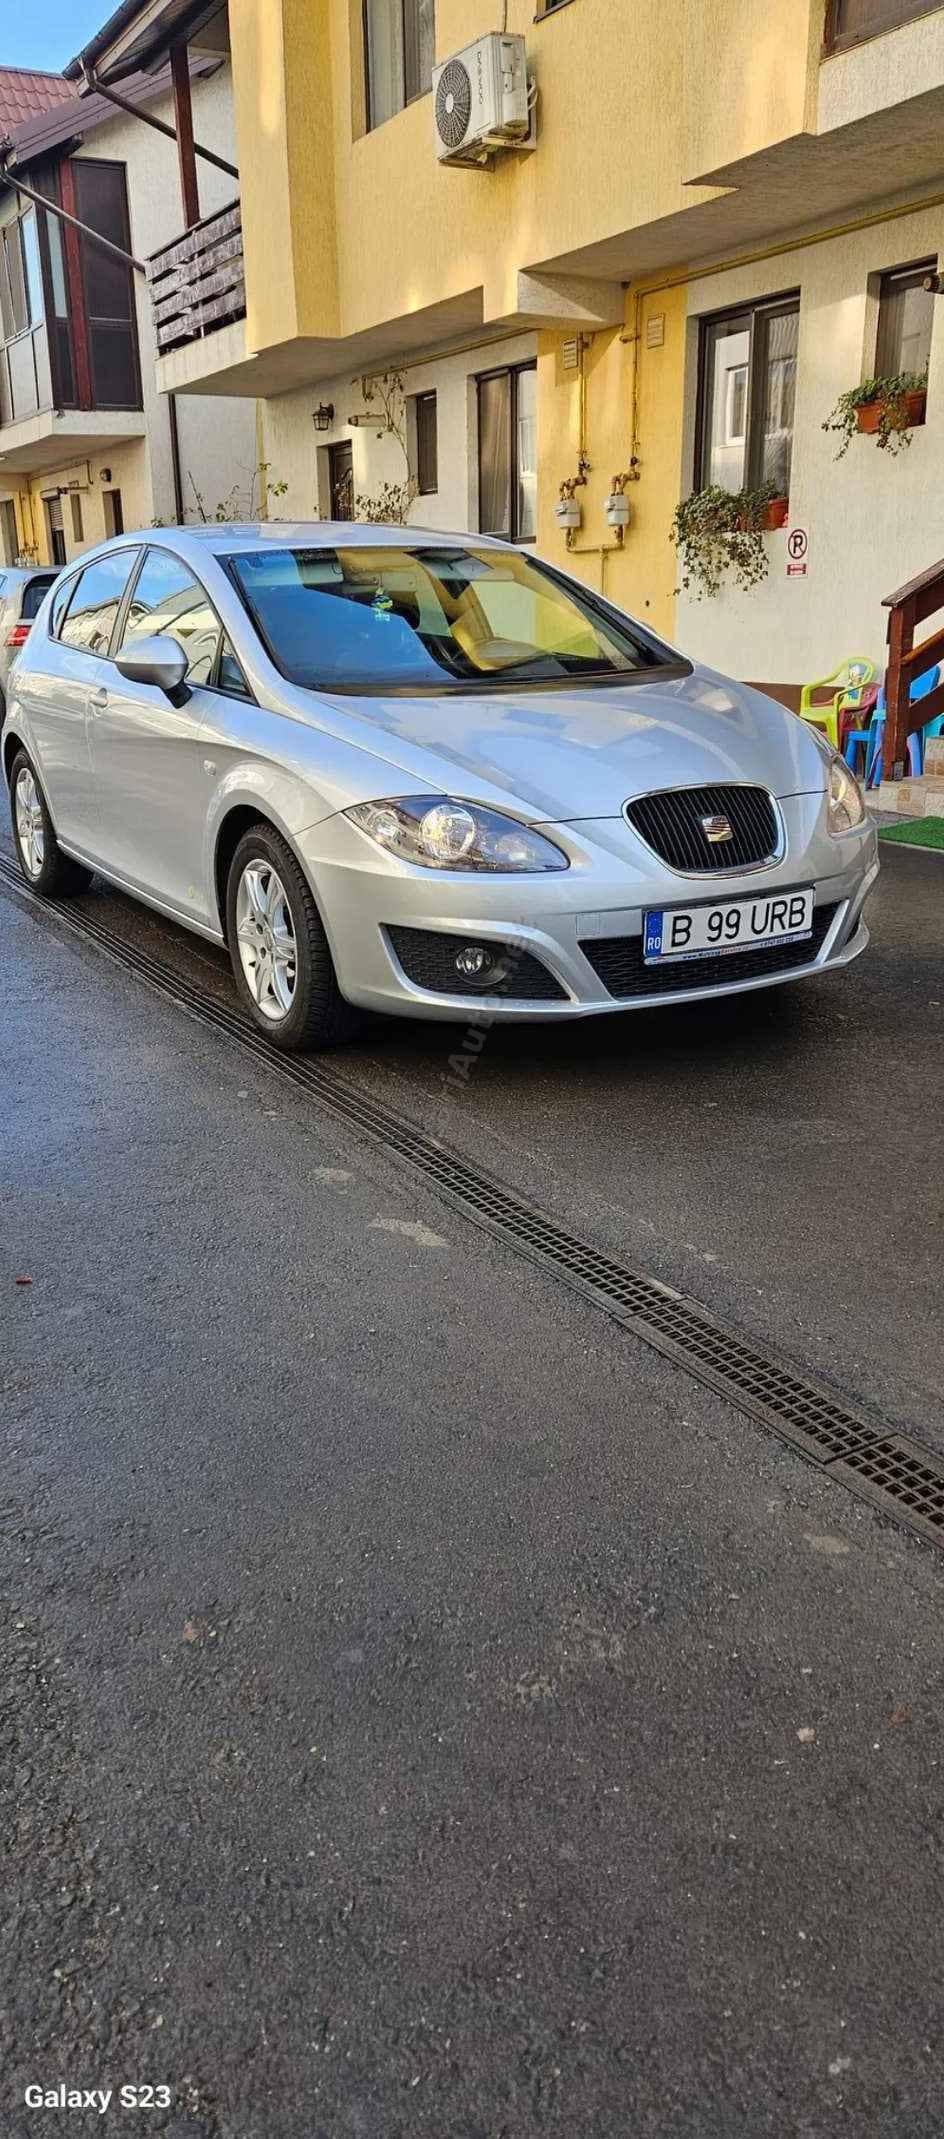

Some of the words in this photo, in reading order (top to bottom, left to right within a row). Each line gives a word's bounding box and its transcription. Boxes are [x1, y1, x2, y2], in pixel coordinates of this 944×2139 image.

[671, 914, 693, 948] B
[707, 908, 741, 943] 99
[750, 896, 806, 935] URB
[647, 937, 661, 950] RO
